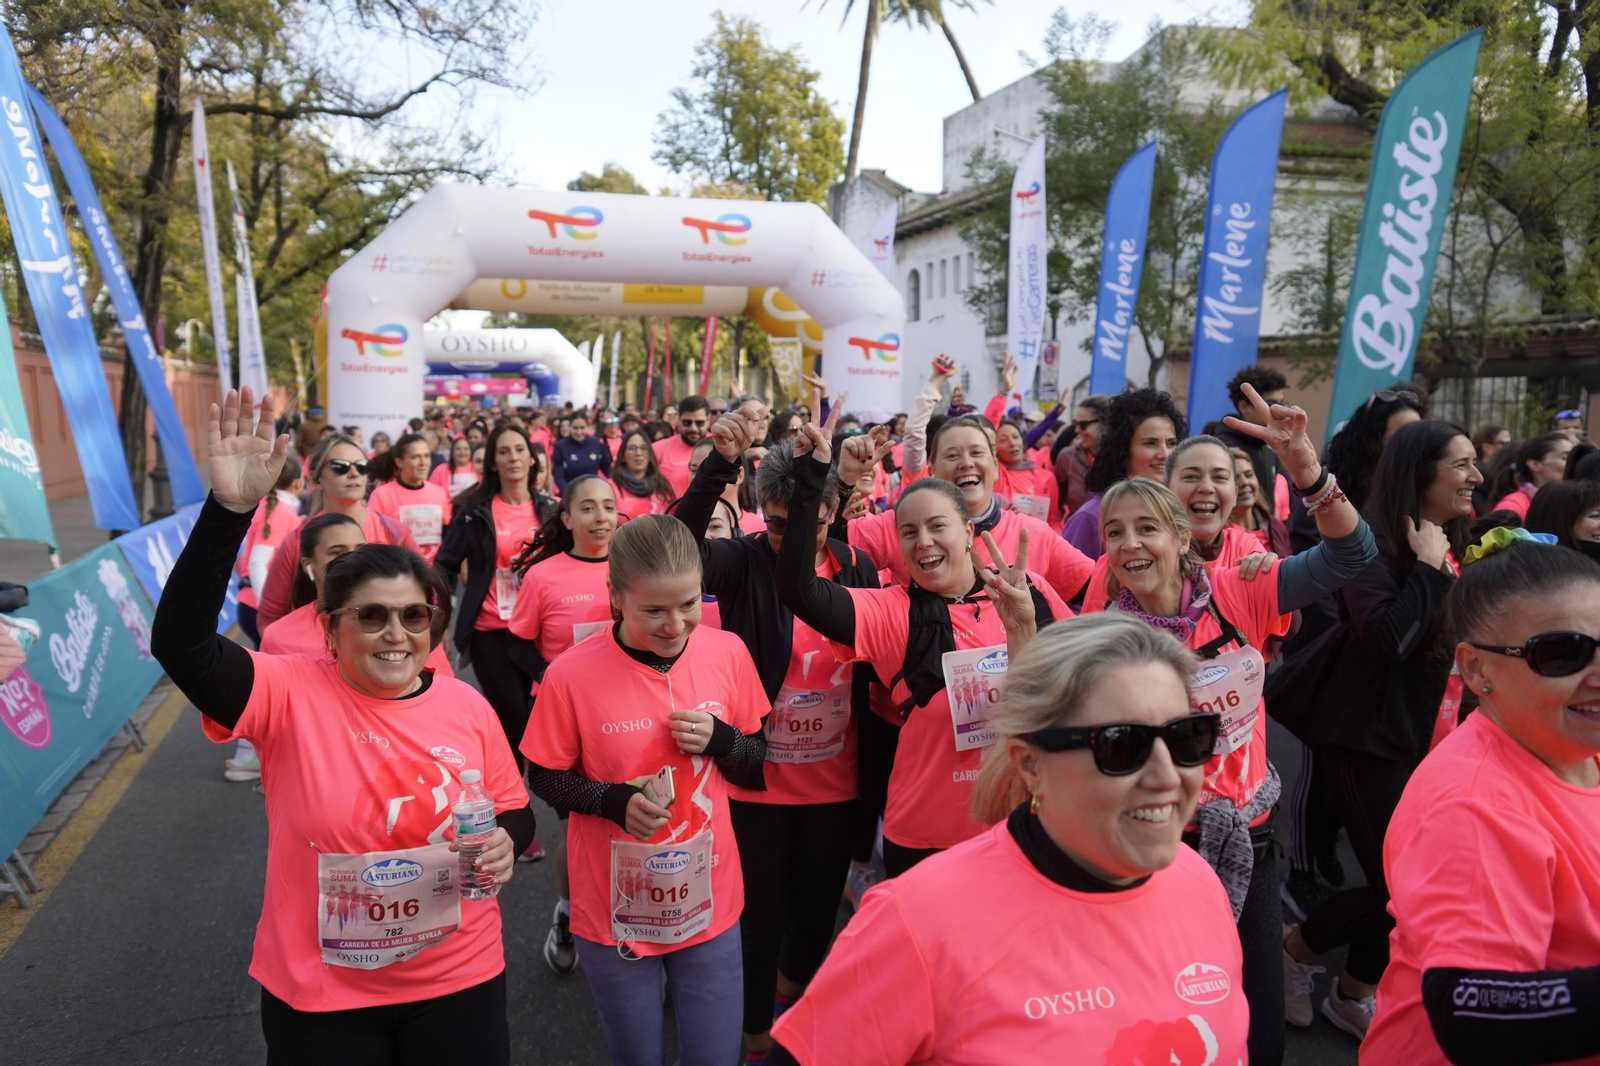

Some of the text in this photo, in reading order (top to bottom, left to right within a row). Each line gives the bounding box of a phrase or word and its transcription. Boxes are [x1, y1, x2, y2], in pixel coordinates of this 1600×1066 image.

[1353, 109, 1448, 377] Batiste
[527, 246, 604, 260] TotalEnergies
[681, 251, 752, 265] TotalEnergies
[1202, 202, 1259, 344] Marlene
[1099, 238, 1138, 361] Marlene
[441, 335, 527, 352] OYSHO
[340, 362, 408, 376] TotalEnergies
[561, 593, 595, 605] OYSHO
[953, 667, 975, 676] SUMA
[981, 660, 1008, 670] ASTURI
[1191, 668, 1227, 685] STURIANA
[1199, 690, 1240, 714] 016
[17, 708, 44, 735] ESPAÑA
[602, 717, 652, 735] OYSHO
[789, 718, 823, 732] 016
[349, 727, 389, 749] YSHO
[953, 770, 982, 783] CARR
[620, 860, 642, 869] SUMA
[330, 874, 358, 883] SUMA
[366, 869, 419, 882] ASTURIANA
[650, 883, 689, 903] 016
[368, 898, 420, 922] 016
[661, 908, 682, 918] 6758
[628, 917, 653, 925] CARRERA
[385, 927, 404, 937] 782
[391, 937, 413, 946] MUJER
[418, 930, 442, 941] SEVILLA
[624, 927, 661, 938] OYSHO
[337, 952, 379, 963] OYSHO
[1024, 986, 1115, 1020] OYSHO
